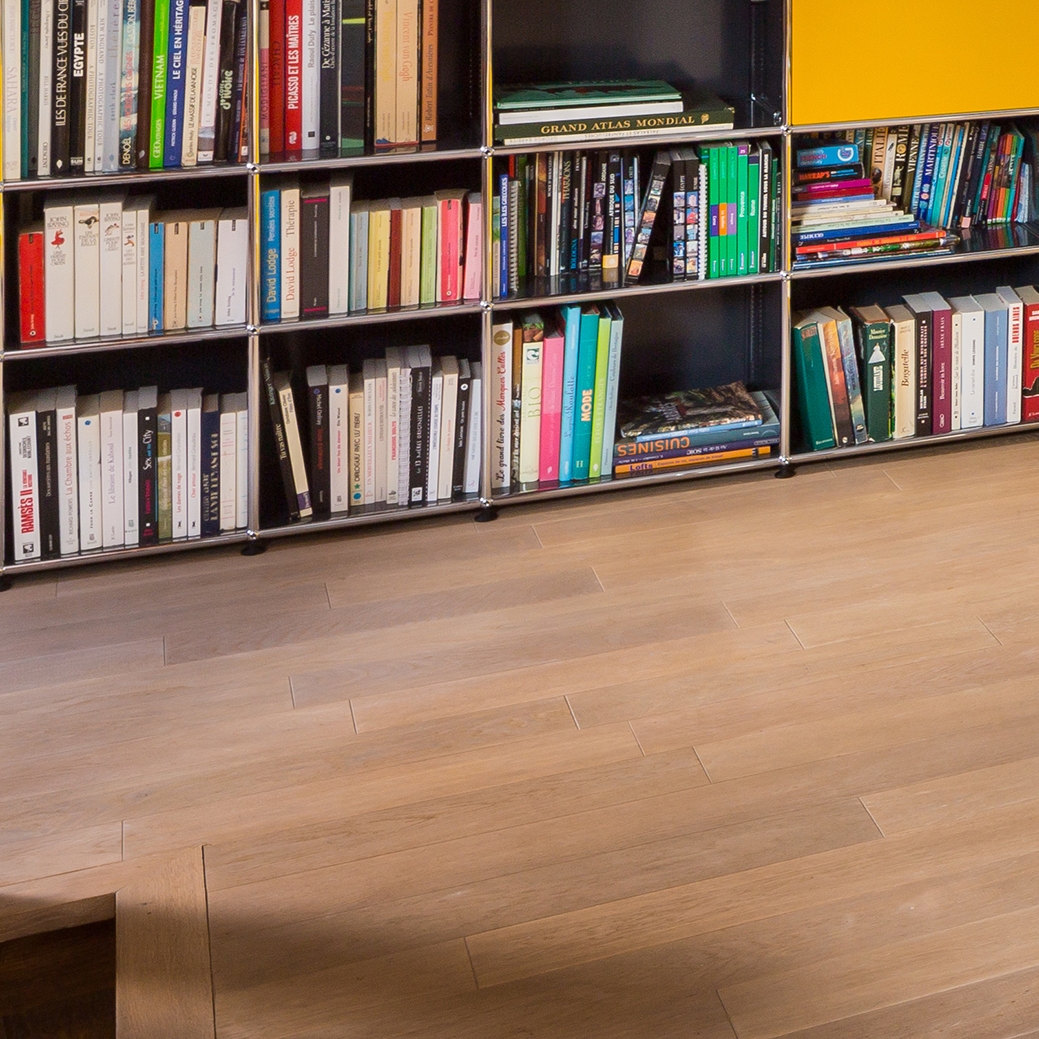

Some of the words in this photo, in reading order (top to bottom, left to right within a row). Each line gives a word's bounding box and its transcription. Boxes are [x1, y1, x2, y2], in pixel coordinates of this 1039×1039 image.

[57, 13, 68, 29] DU
[286, 15, 299, 48] MAÎTRES
[308, 17, 315, 25] Le
[403, 12, 413, 43] Vincent
[57, 30, 68, 55] VUES
[174, 38, 182, 48] EN
[308, 30, 316, 46] Dufy
[322, 26, 331, 56] Cézanne
[74, 33, 84, 77] EGYPTE
[173, 51, 182, 68] CIEL
[288, 50, 299, 64] LES
[307, 48, 315, 68] Raoul
[322, 59, 330, 68] De
[56, 57, 67, 92] FRANCE
[154, 54, 164, 100] VIETNAM
[172, 70, 181, 79] LE
[288, 65, 298, 74] ET
[399, 61, 413, 82] Gogh
[56, 94, 66, 107] DE
[288, 77, 298, 109] PICASSO
[55, 110, 66, 126] ILES
[540, 123, 590, 135] GRAND
[593, 120, 631, 131] ATLAS
[636, 116, 694, 127] MONDIAL
[873, 127, 885, 163] ITALIE
[896, 125, 908, 161] ROME
[908, 138, 918, 172] VIENNE
[925, 123, 939, 176] MARTINIQUE
[563, 161, 571, 199] PHARAONS
[286, 201, 295, 237] Thérapie
[267, 248, 278, 275] Lodge
[286, 248, 297, 273] Lodge
[266, 279, 276, 303] David
[286, 275, 294, 300] David
[901, 349, 910, 387] Bagatelle
[496, 377, 507, 411] Marques
[527, 387, 541, 418] BIO
[581, 389, 592, 421] MODE
[497, 413, 505, 425] des
[496, 427, 505, 444] livre
[617, 436, 690, 456] CUISINES
[496, 446, 506, 467] grand
[630, 463, 653, 472] Lofts
[64, 457, 72, 485] Chambre
[495, 469, 504, 482] Le
[64, 486, 72, 495] La
[109, 495, 116, 504] Le
[17, 497, 34, 533] RAMSÈS
